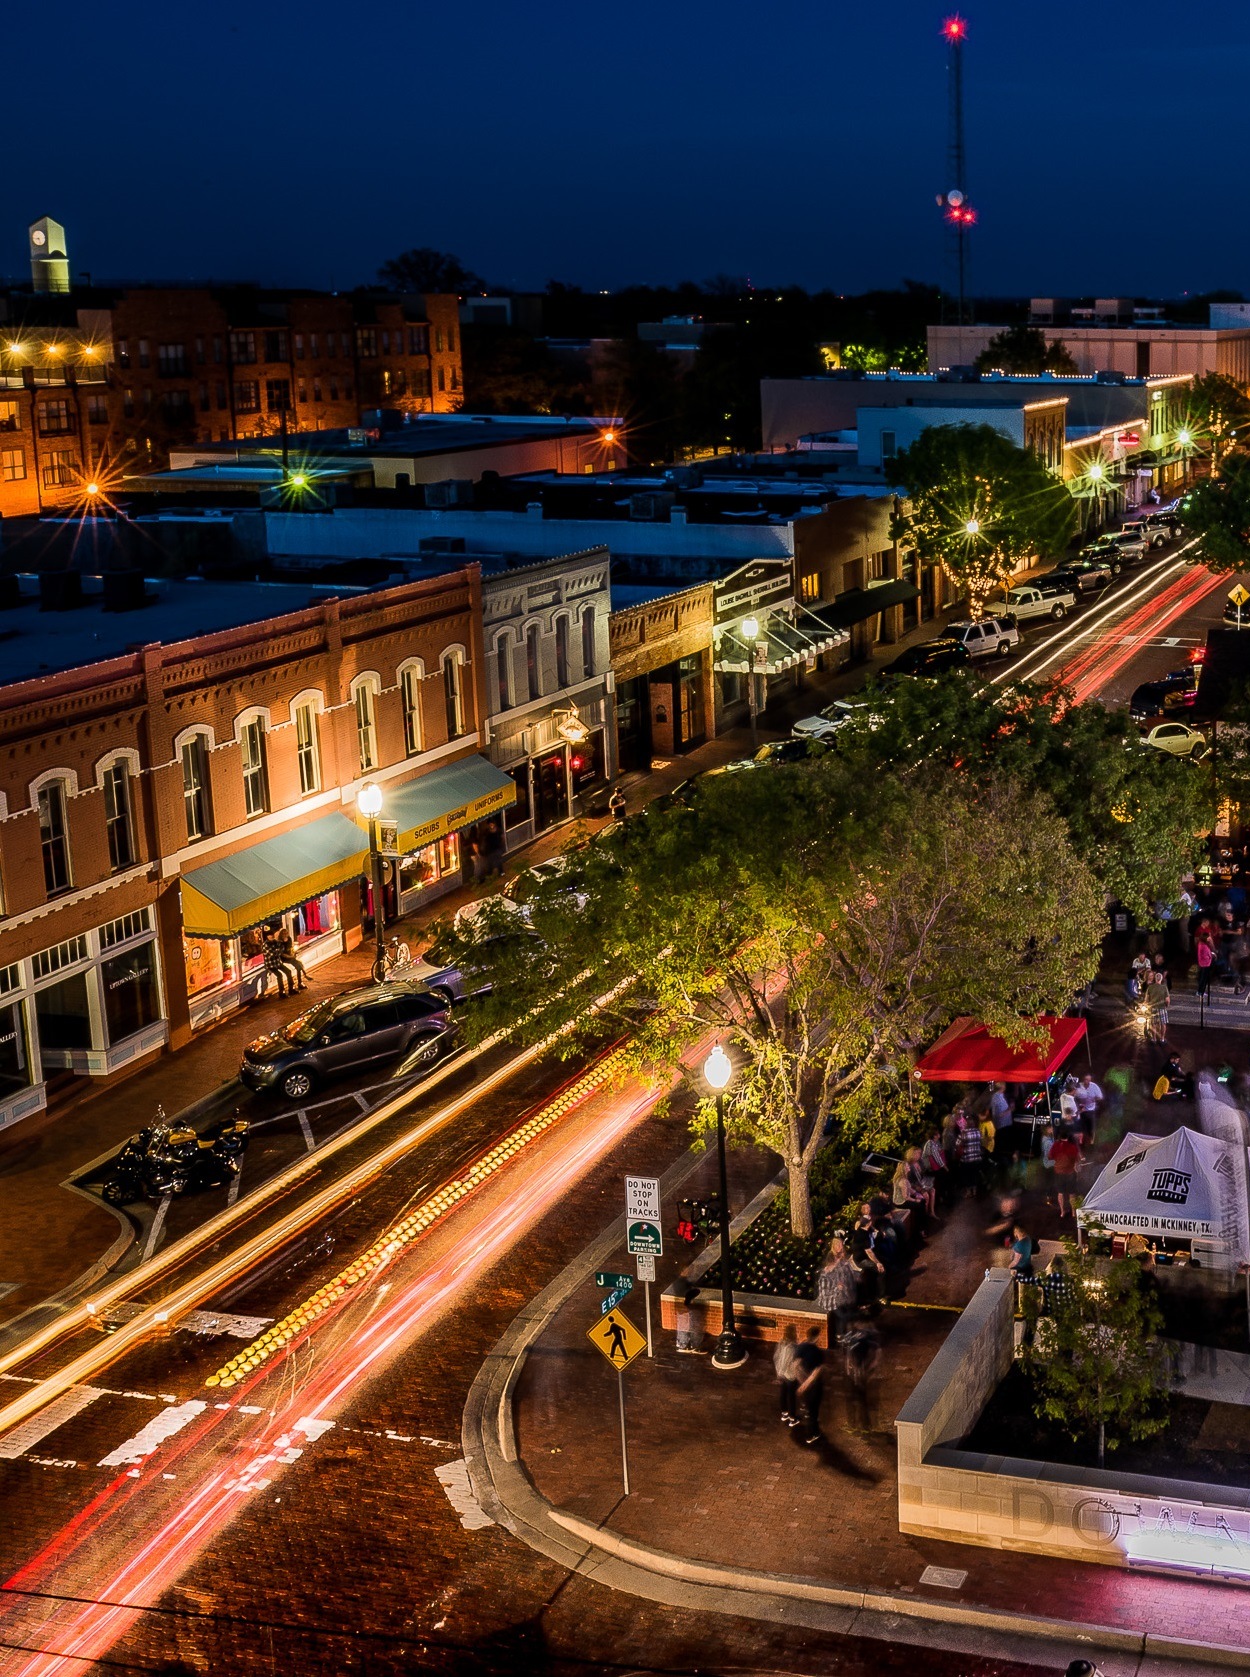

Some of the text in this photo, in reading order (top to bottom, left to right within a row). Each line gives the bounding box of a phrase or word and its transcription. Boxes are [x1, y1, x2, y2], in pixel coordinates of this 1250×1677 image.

[720, 596, 735, 607] LOUISE
[414, 791, 504, 840] SCRUBS UNIFORMS
[109, 967, 149, 990] UPTOWN GALLERY
[628, 1180, 656, 1190] DO NOT
[1150, 1171, 1192, 1195] TUPPS
[632, 1190, 653, 1199] STOP
[1152, 1191, 1182, 1200] BREWERY
[637, 1199, 649, 1207] ON
[628, 1207, 659, 1218] TRACKS
[1100, 1212, 1150, 1228] HANDCRAFTED
[1151, 1217, 1159, 1229] IN
[1160, 1218, 1199, 1234] MCKINNEY,
[629, 1241, 661, 1249] DOWNTOWN
[633, 1246, 657, 1254] PARKING
[597, 1274, 605, 1286] J
[618, 1275, 631, 1283] Ave
[615, 1281, 633, 1289] 1400
[601, 1300, 608, 1314] E
